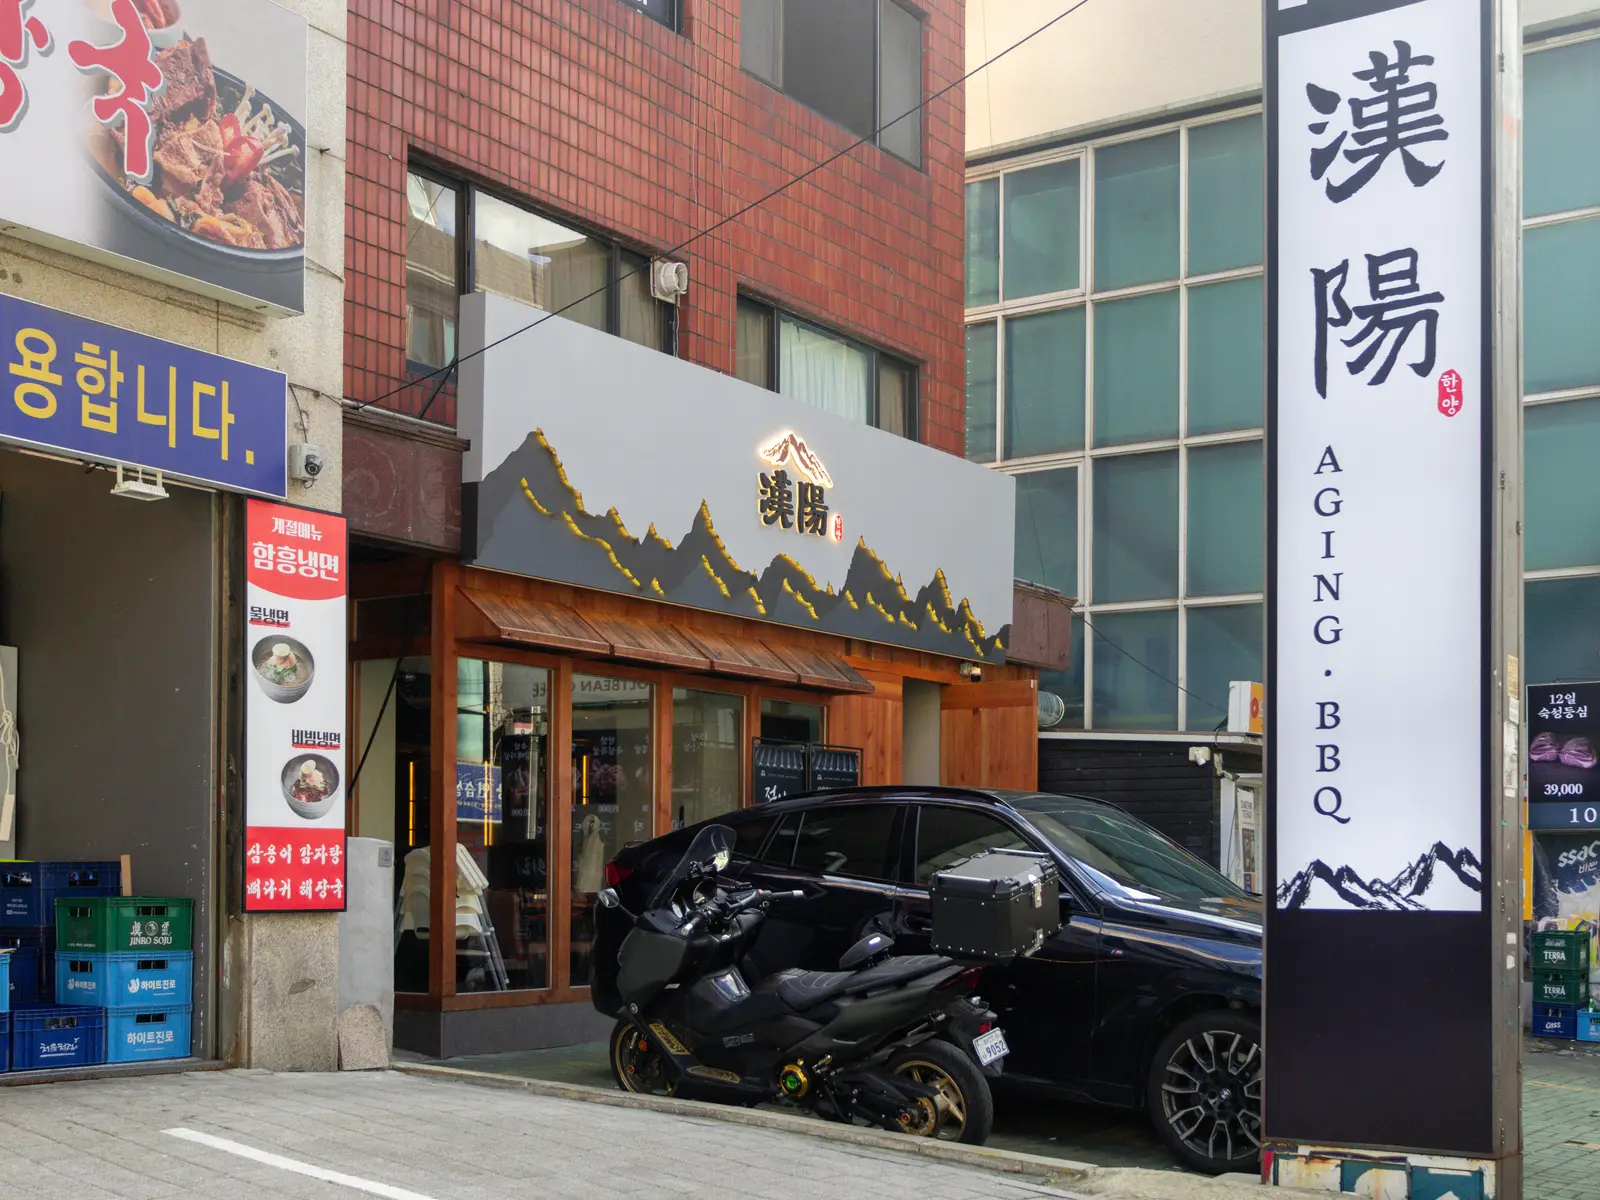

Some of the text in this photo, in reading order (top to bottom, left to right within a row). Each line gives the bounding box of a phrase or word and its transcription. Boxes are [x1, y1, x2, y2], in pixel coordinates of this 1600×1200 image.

[1306, 40, 1449, 400] 漢陽
[9, 328, 255, 465] 용합니다.
[1441, 373, 1460, 415] 한양
[759, 469, 829, 536] 漢陽
[271, 516, 323, 541] 계절메뉴
[1313, 445, 1344, 645] AGING
[252, 541, 339, 582] 함흥냉면
[250, 606, 289, 627] 물냉면
[1549, 692, 1576, 705] 12일
[1538, 706, 1588, 719] 숙성등심
[291, 729, 341, 749] 비빔냉면
[1313, 701, 1351, 824] BBQ
[1543, 783, 1584, 797] 39,000
[247, 842, 343, 865] 삼용이 감자탕
[247, 878, 343, 900] 뼈다귀 해장국
[129, 936, 172, 946] JINRO SOJU
[1543, 950, 1566, 961] TERRA
[140, 979, 176, 990] 하이트진로
[1543, 985, 1566, 996] TERRA
[127, 1030, 174, 1046] 하이트진로
[985, 1040, 1006, 1058] 9052
